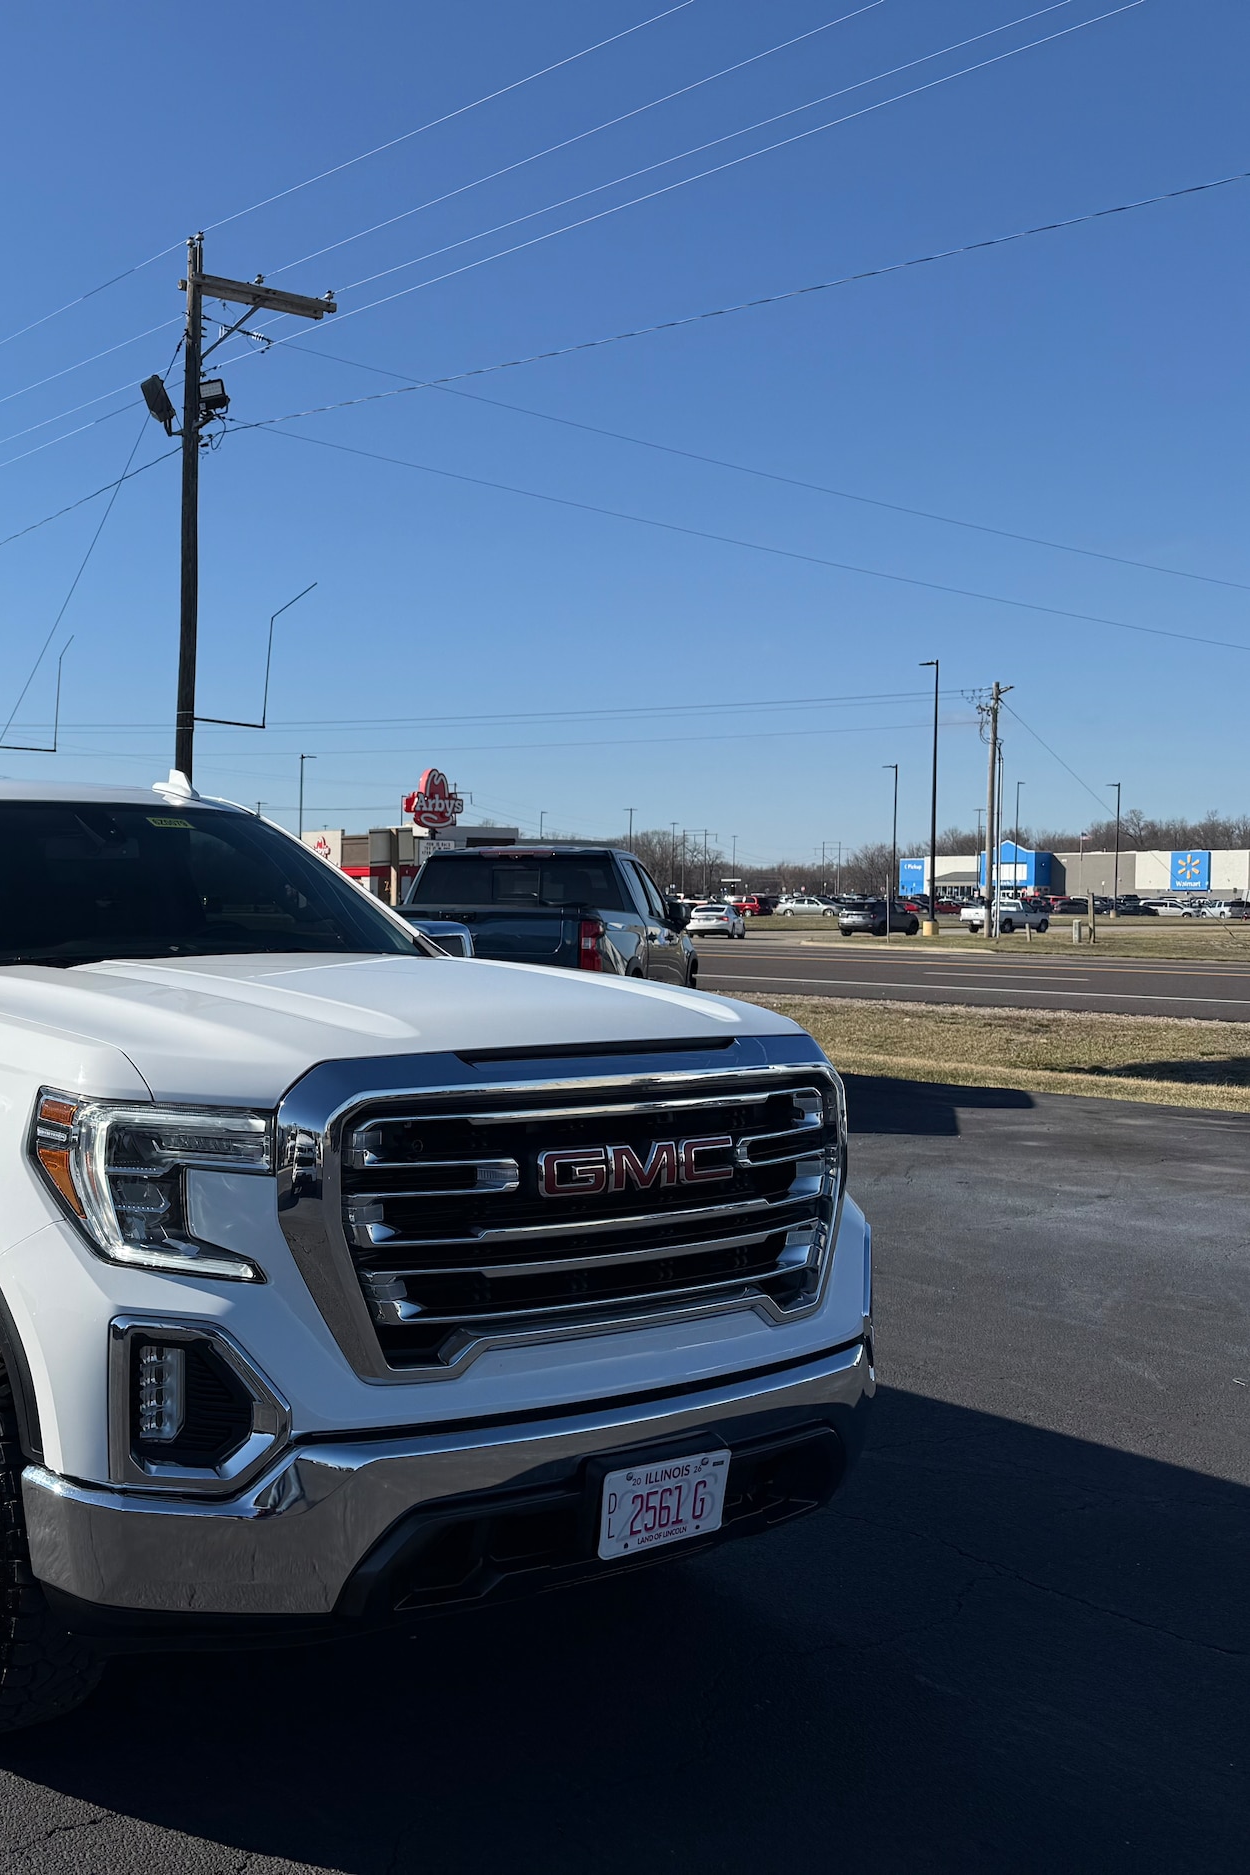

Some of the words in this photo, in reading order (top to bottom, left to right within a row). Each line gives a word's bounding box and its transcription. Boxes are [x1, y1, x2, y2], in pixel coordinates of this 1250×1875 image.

[907, 863, 922, 871] Pickup
[1175, 880, 1201, 888] Walmart
[537, 1135, 734, 1198] GMC
[632, 1477, 642, 1486] 20
[645, 1464, 690, 1485] ILLINOIS
[693, 1465, 702, 1474] 26
[629, 1484, 683, 1537] 2561
[691, 1479, 708, 1520] G
[637, 1534, 654, 1545] LAND
[654, 1531, 663, 1540] OF
[662, 1526, 687, 1538] LINCOLN
